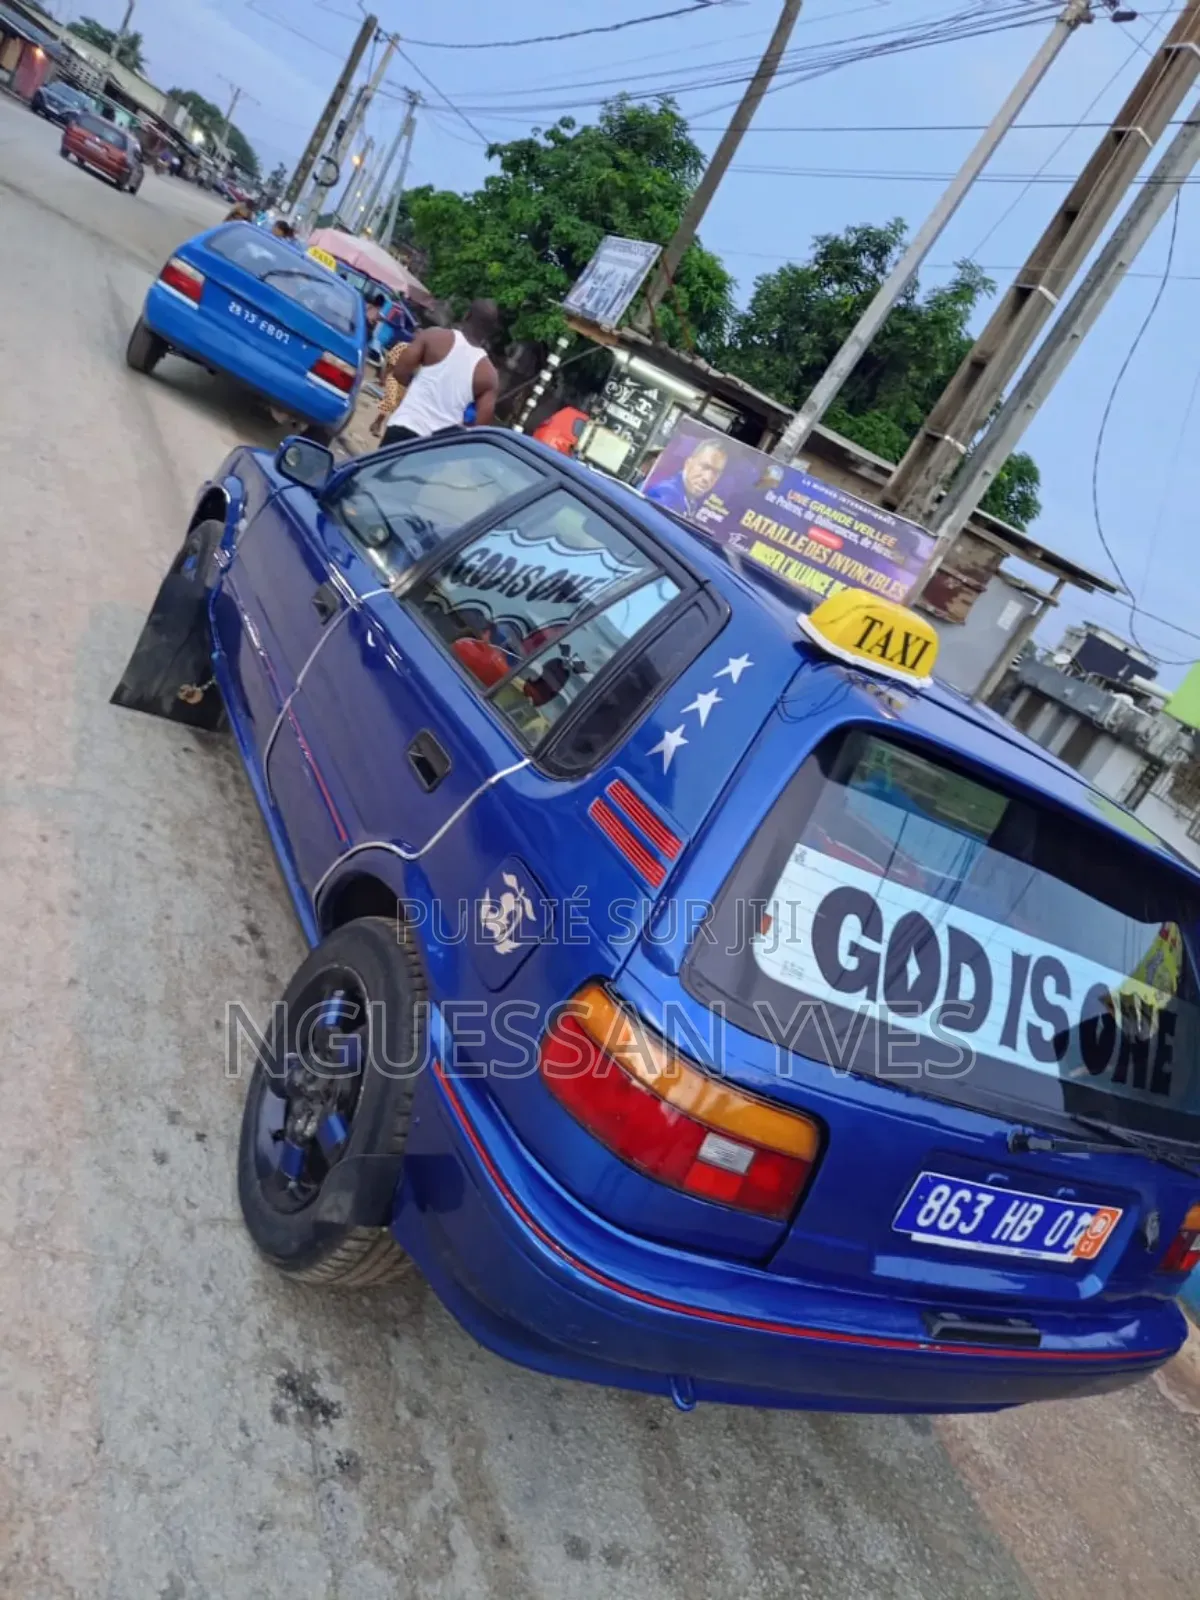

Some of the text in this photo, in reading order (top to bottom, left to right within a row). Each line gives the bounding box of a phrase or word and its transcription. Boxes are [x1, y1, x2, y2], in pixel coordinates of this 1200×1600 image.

[809, 500, 850, 527] GRANDE
[741, 509, 809, 553] BATAILLE
[803, 538, 832, 564] DES
[827, 552, 908, 599] INVINCIBLES
[853, 615, 933, 670] TAXI
[811, 885, 1178, 1097] GOD IS ONE
[916, 1184, 995, 1235] 863
[991, 1200, 1045, 1242] HB
